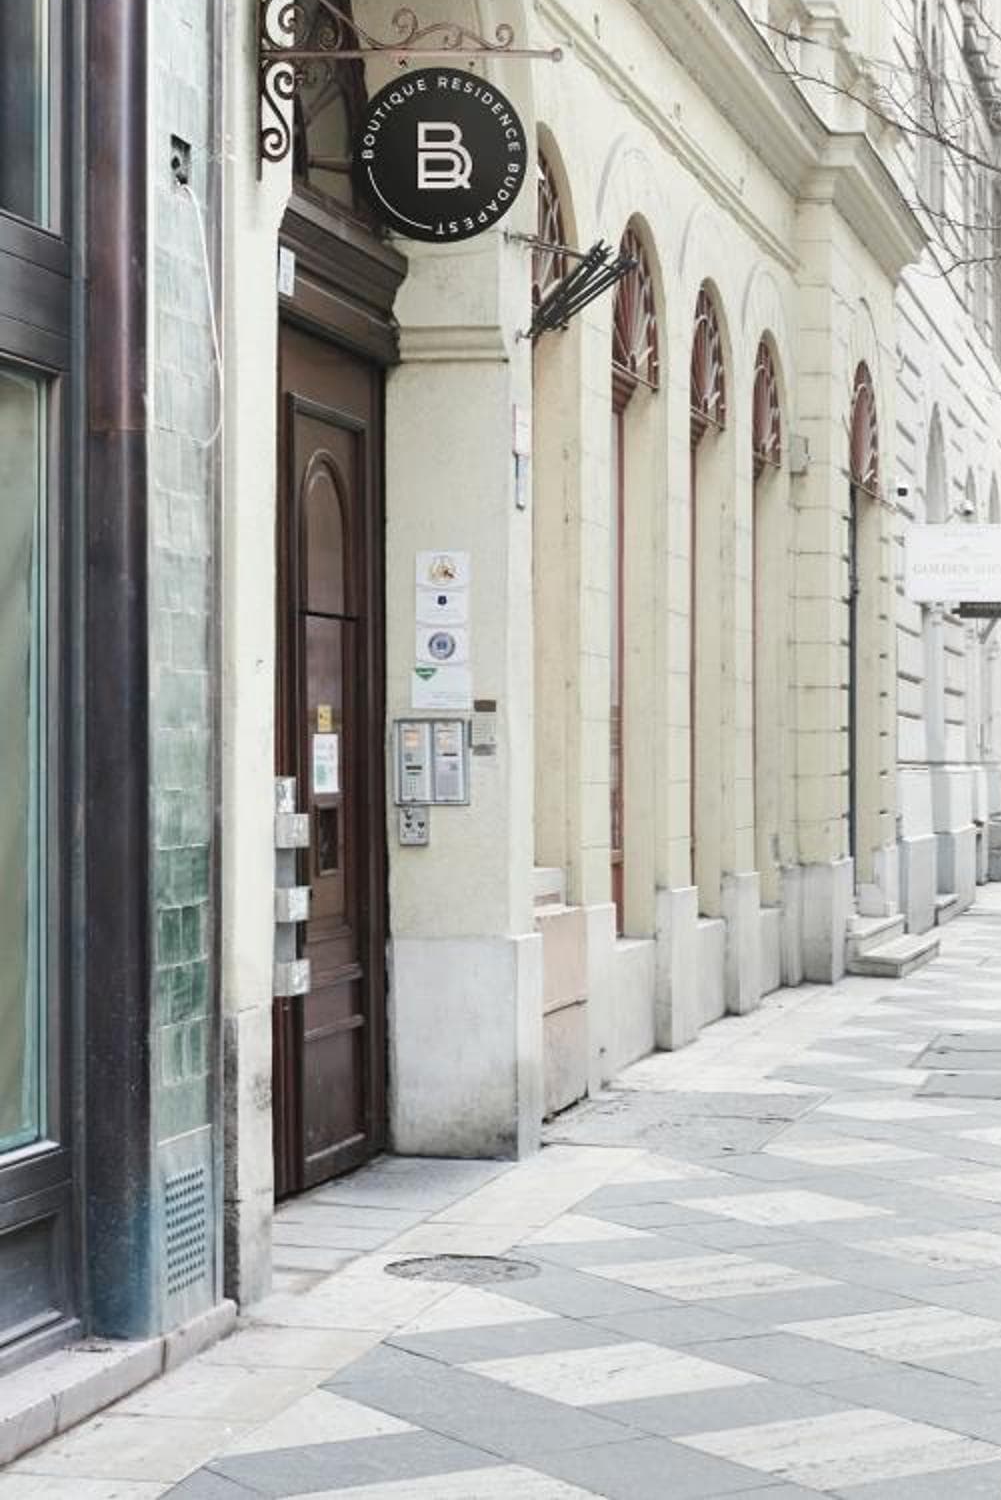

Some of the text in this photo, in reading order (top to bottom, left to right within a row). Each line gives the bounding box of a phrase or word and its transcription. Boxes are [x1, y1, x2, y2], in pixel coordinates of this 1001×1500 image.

[361, 76, 521, 236] BOUTIQUE RESIDENCE BUDAPEST
